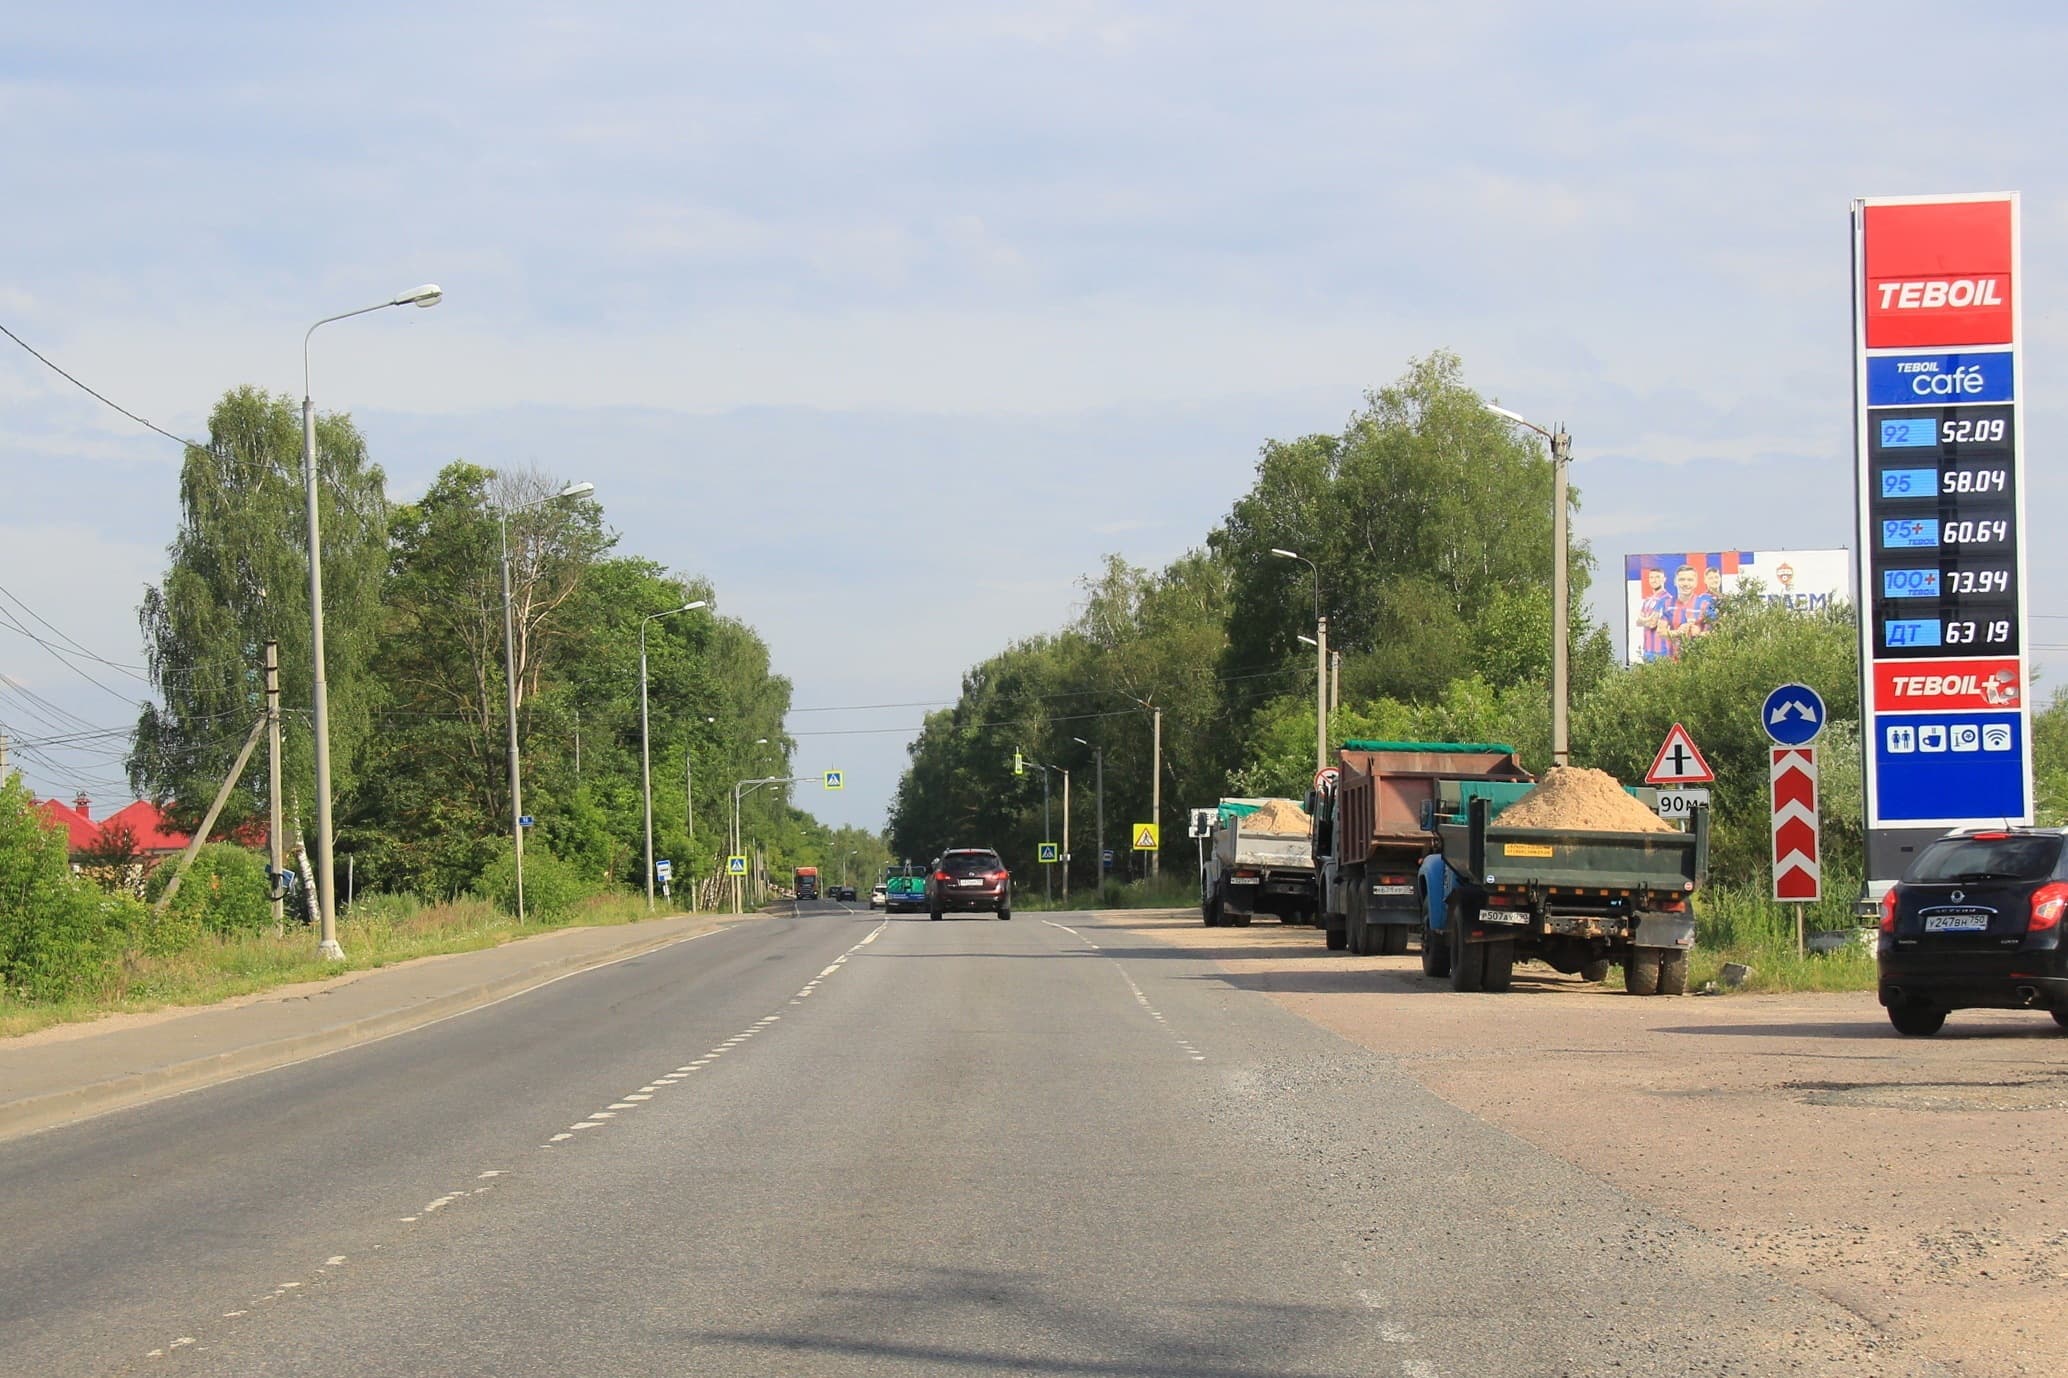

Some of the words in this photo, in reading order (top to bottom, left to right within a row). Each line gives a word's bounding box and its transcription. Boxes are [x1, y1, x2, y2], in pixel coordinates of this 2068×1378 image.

[1878, 279, 2002, 310] TEBOIL
[1896, 361, 1940, 374] TEBOIL
[1911, 364, 1984, 396] café
[1883, 425, 1910, 443] 92
[1940, 419, 2005, 444] 52.09
[1884, 475, 1911, 493] 95
[1941, 470, 2006, 494] 58.04
[1943, 520, 2007, 544] 60.64
[1946, 570, 2009, 594] 73.94
[1887, 624, 1922, 646] ДТ
[1892, 674, 1982, 697] TEBOIL
